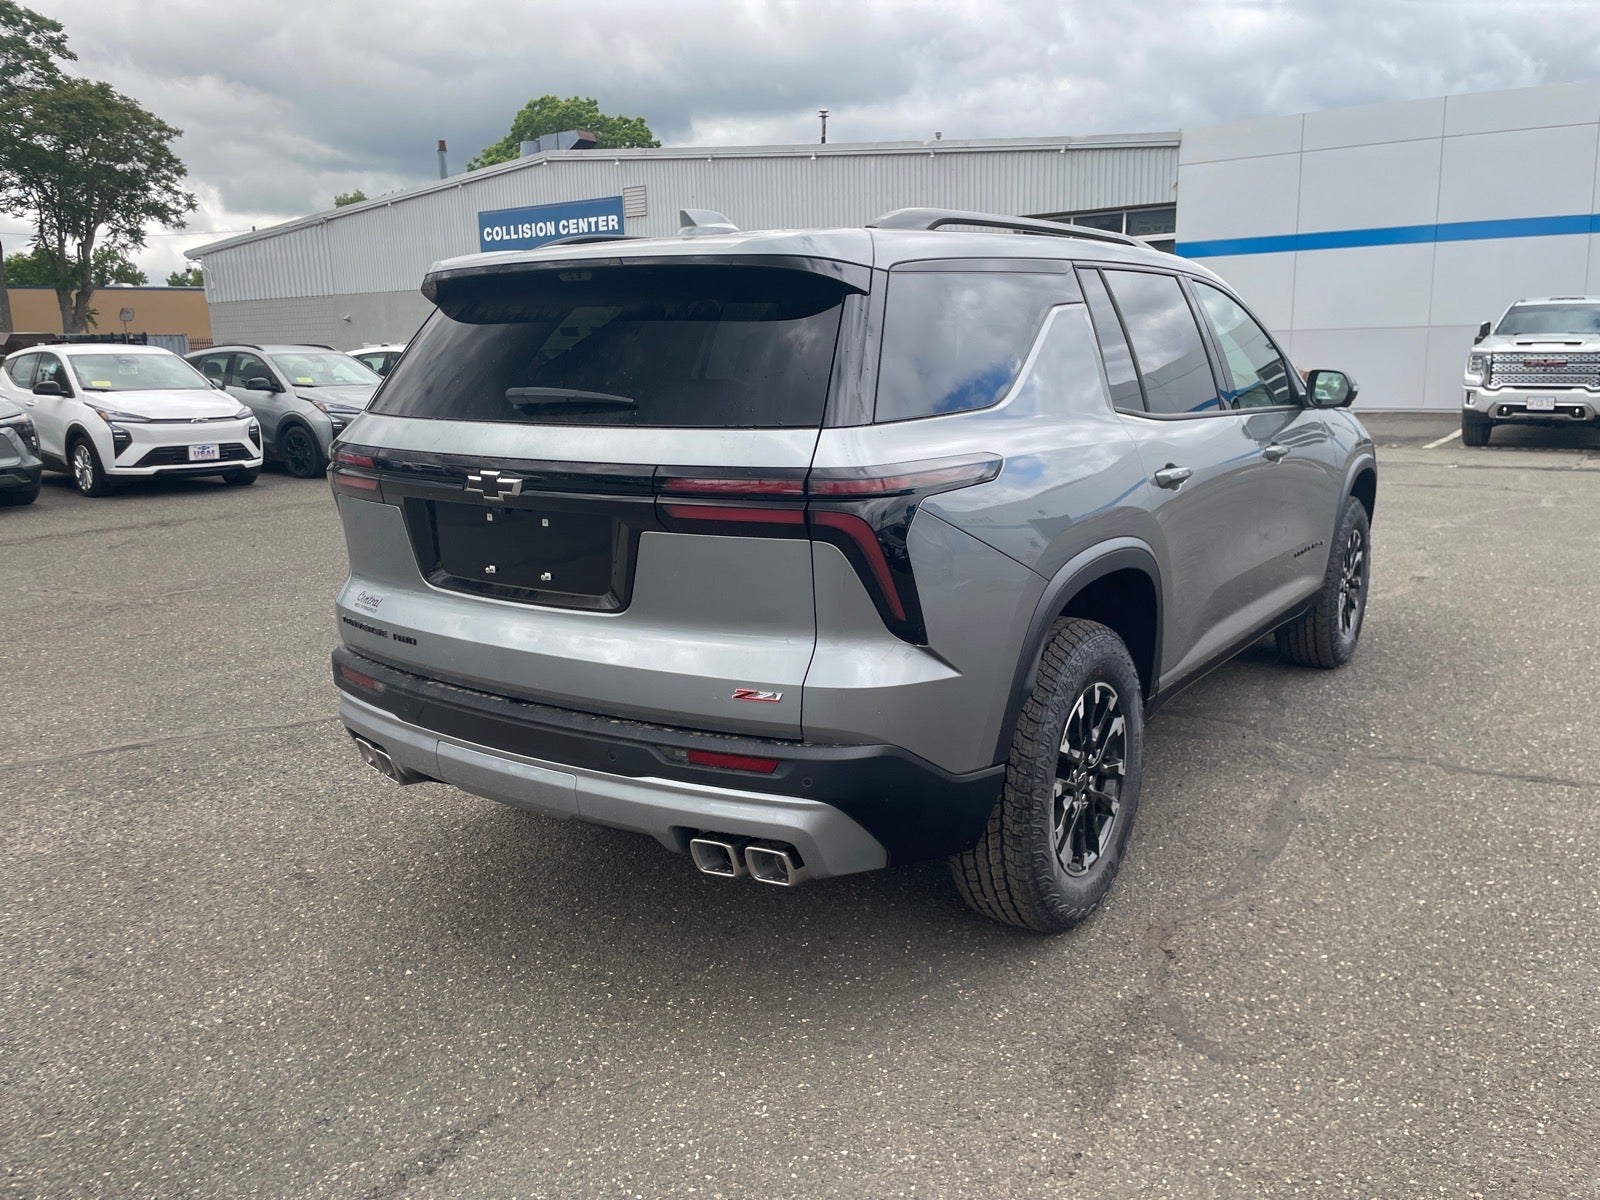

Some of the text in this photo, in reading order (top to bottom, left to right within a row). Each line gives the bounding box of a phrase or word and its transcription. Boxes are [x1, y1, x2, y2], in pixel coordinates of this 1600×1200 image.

[483, 214, 619, 242] COLLISION CENTER
[357, 590, 384, 608] Central
[731, 688, 784, 703] Z71
